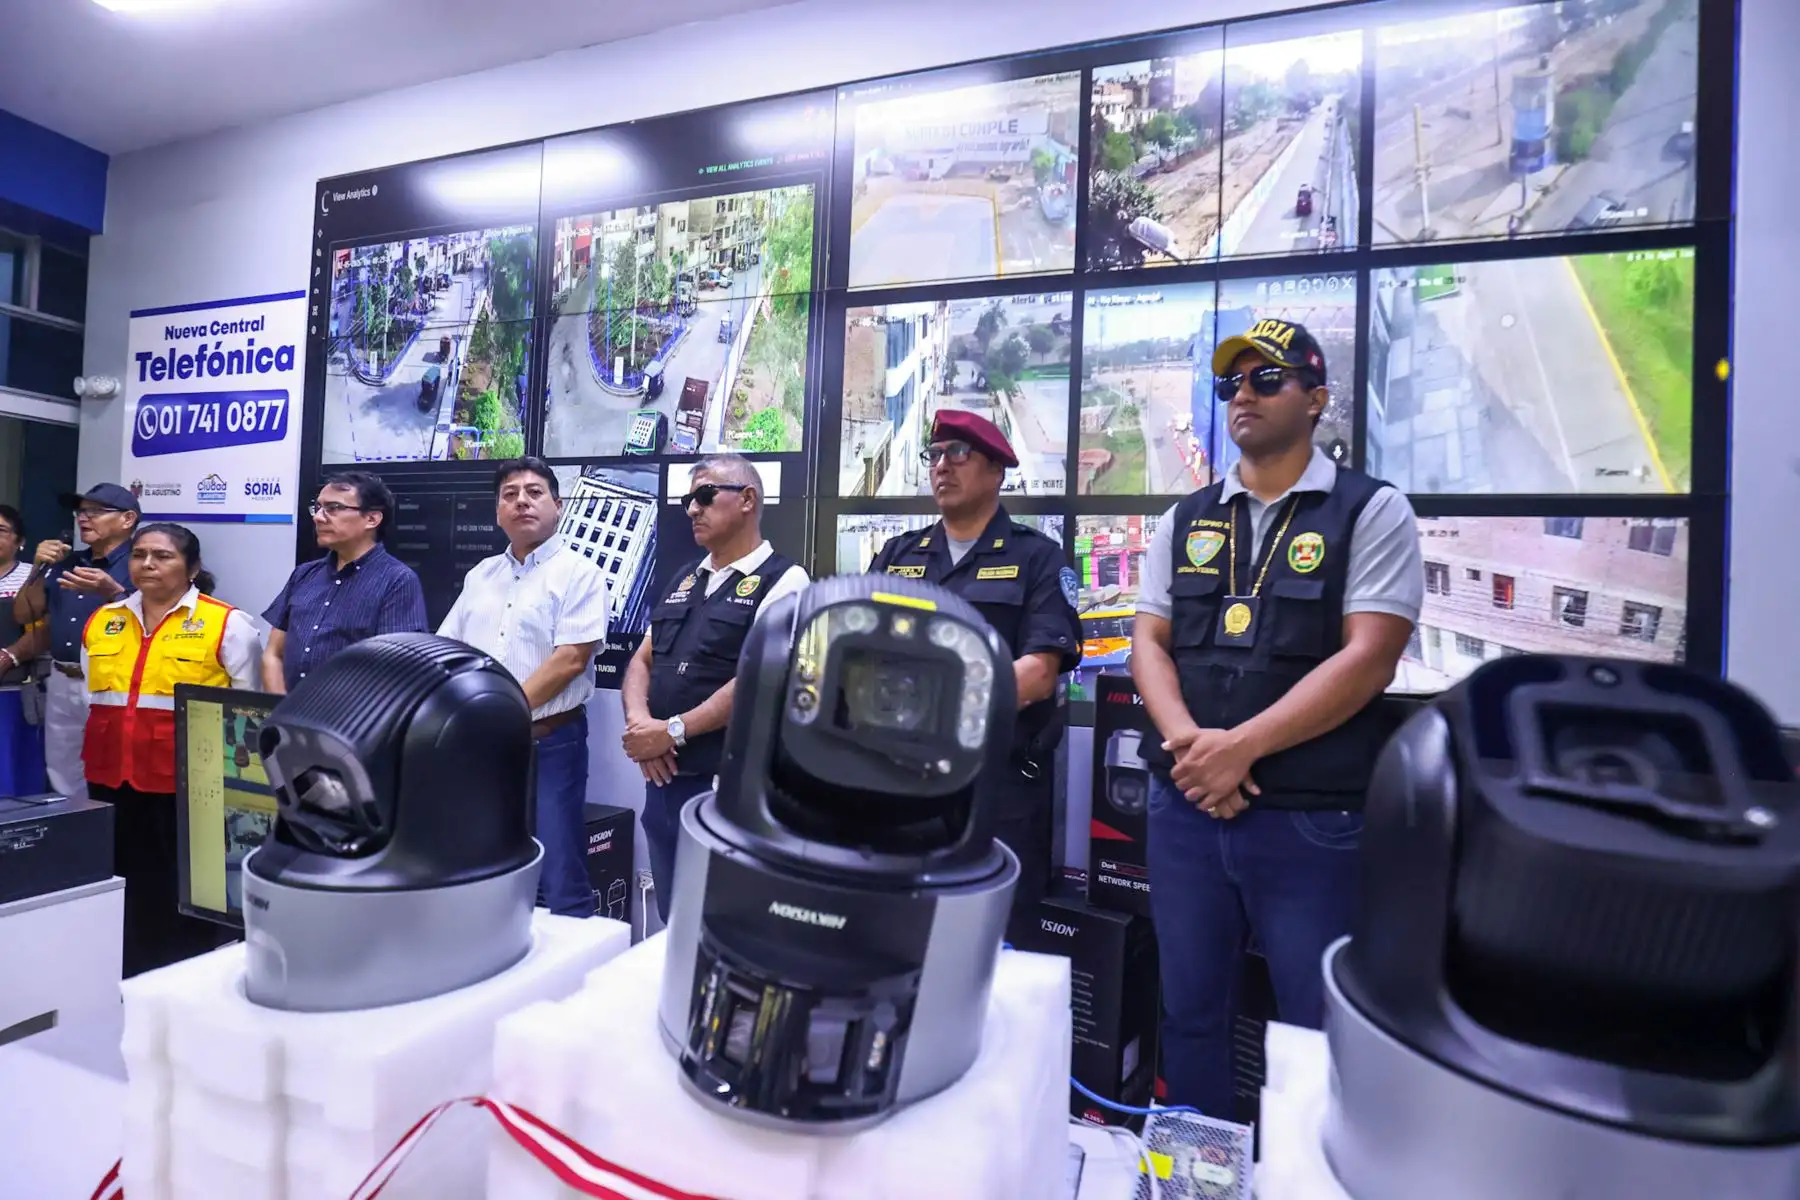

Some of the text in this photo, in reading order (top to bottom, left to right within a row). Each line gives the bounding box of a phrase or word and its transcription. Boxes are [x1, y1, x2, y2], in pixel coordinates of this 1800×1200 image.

[333, 187, 371, 202] View Analytics
[165, 315, 264, 340] Nueva Central
[135, 338, 295, 382] Telefónica
[159, 399, 286, 435] 01 741 0877
[152, 488, 182, 496] AGUSTINO
[244, 482, 282, 496] SORIA
[589, 829, 614, 844] VISION
[1098, 874, 1132, 888] NETWORK
[1132, 881, 1151, 892] SPEE
[1041, 918, 1077, 937] ISION
